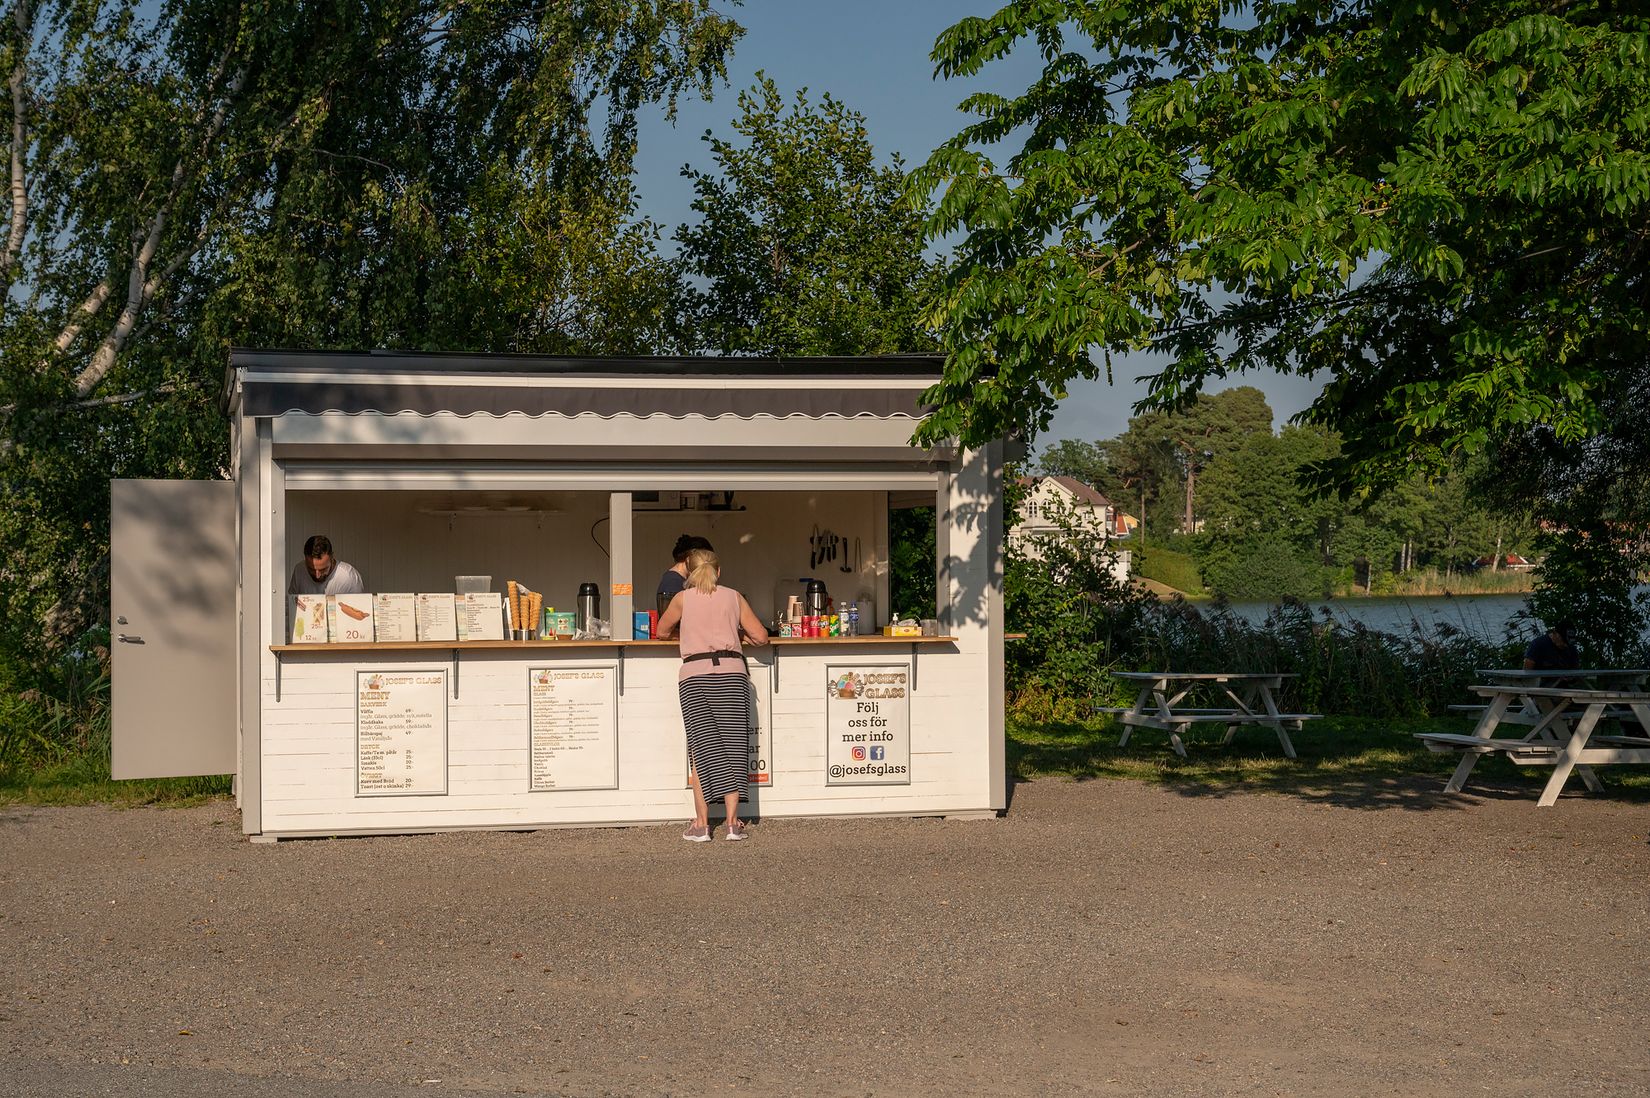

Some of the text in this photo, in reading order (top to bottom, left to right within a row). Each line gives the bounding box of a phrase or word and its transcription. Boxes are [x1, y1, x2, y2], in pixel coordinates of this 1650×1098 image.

[346, 630, 359, 639] 20
[863, 673, 906, 685] JOSEF'S
[360, 692, 390, 700] MENY
[865, 688, 905, 699] GLASS
[857, 702, 879, 715] Följ
[848, 717, 887, 727] oss för
[842, 731, 894, 742] mer info
[830, 763, 906, 778] @josefsglass
